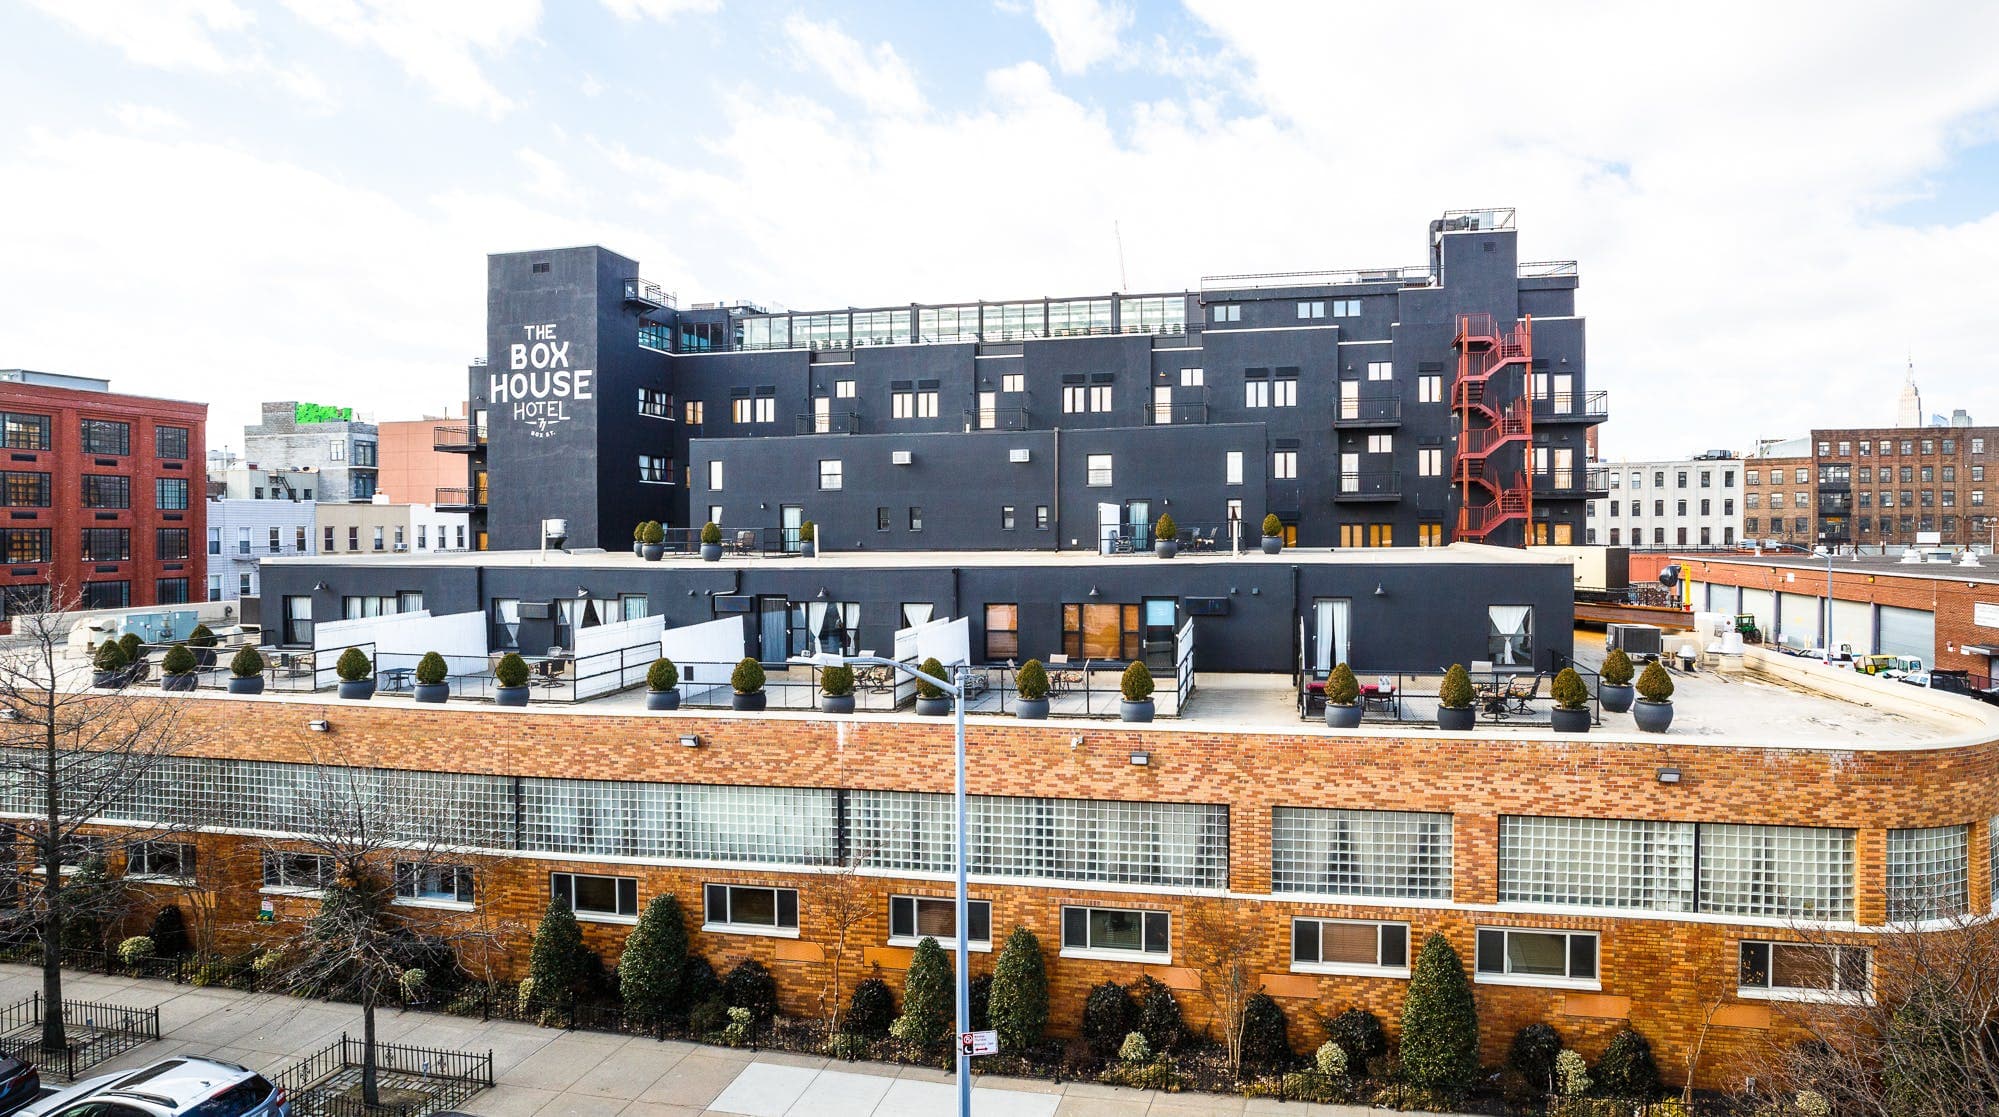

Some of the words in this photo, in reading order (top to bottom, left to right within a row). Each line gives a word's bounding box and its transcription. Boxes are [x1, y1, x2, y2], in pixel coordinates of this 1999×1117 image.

[523, 323, 557, 341] THE
[510, 341, 569, 370] BOX
[490, 369, 593, 404] HOUSE
[513, 400, 571, 421] HOTEL
